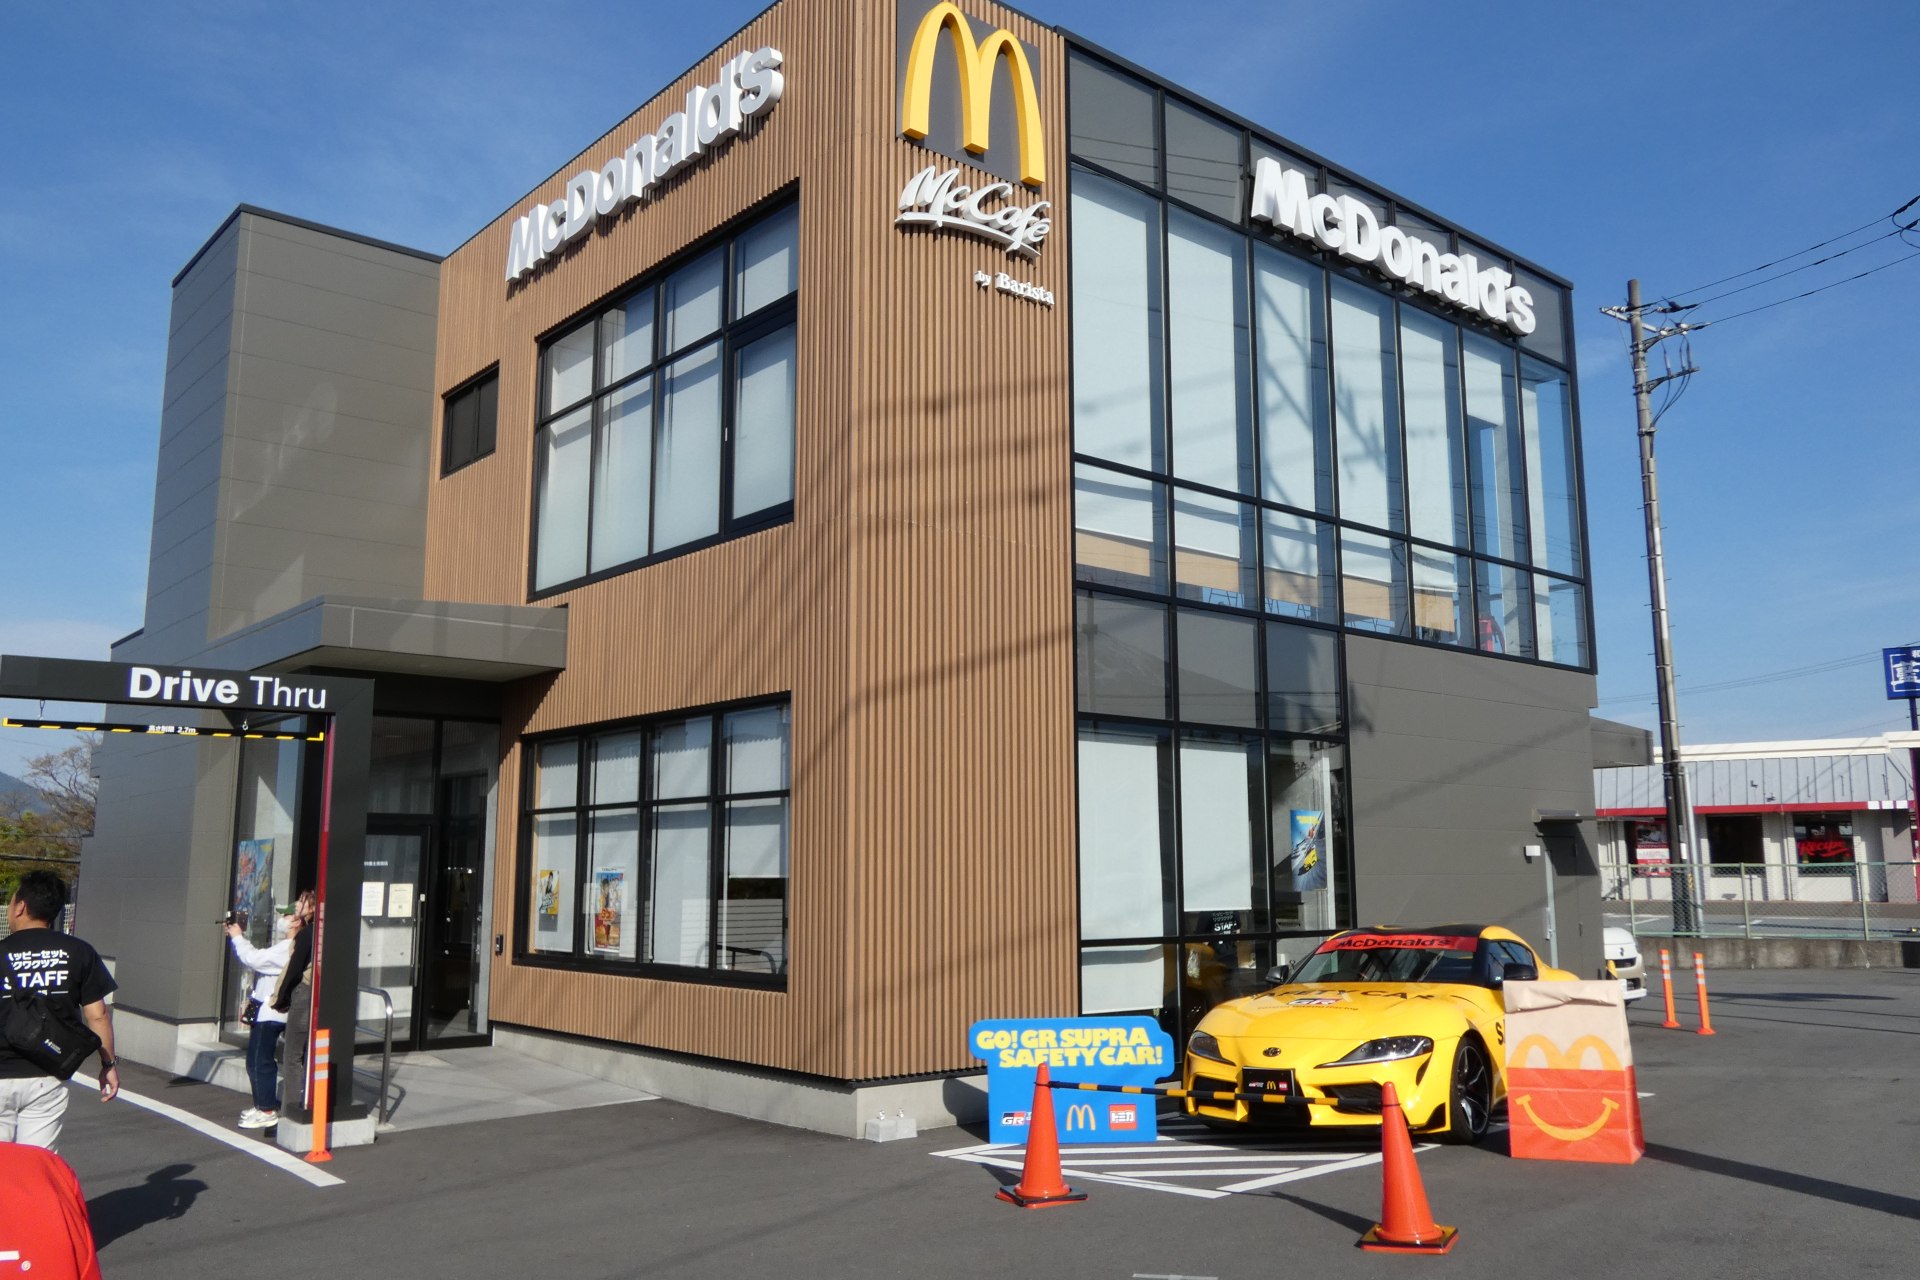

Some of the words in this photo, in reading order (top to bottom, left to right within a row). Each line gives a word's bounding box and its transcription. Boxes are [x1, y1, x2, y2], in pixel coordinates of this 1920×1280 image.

[505, 46, 784, 283] McDonald's
[895, 165, 1052, 258] McCafé
[1251, 156, 1536, 336] McDonald's
[974, 270, 991, 287] by
[994, 272, 1055, 306] Barista
[129, 667, 239, 704] Drive
[250, 676, 327, 709] Thru
[1337, 938, 1451, 948] McDonald's
[11, 958, 68, 970] クワクツアー
[976, 1030, 1018, 1049] GO!
[1020, 1030, 1058, 1049] GR
[1060, 1027, 1150, 1047] SUPRA
[999, 1047, 1099, 1068] SAFETY
[1099, 1046, 1163, 1066] CAR!
[1001, 1113, 1026, 1125] GR
[1110, 1110, 1136, 1123] トミカ
